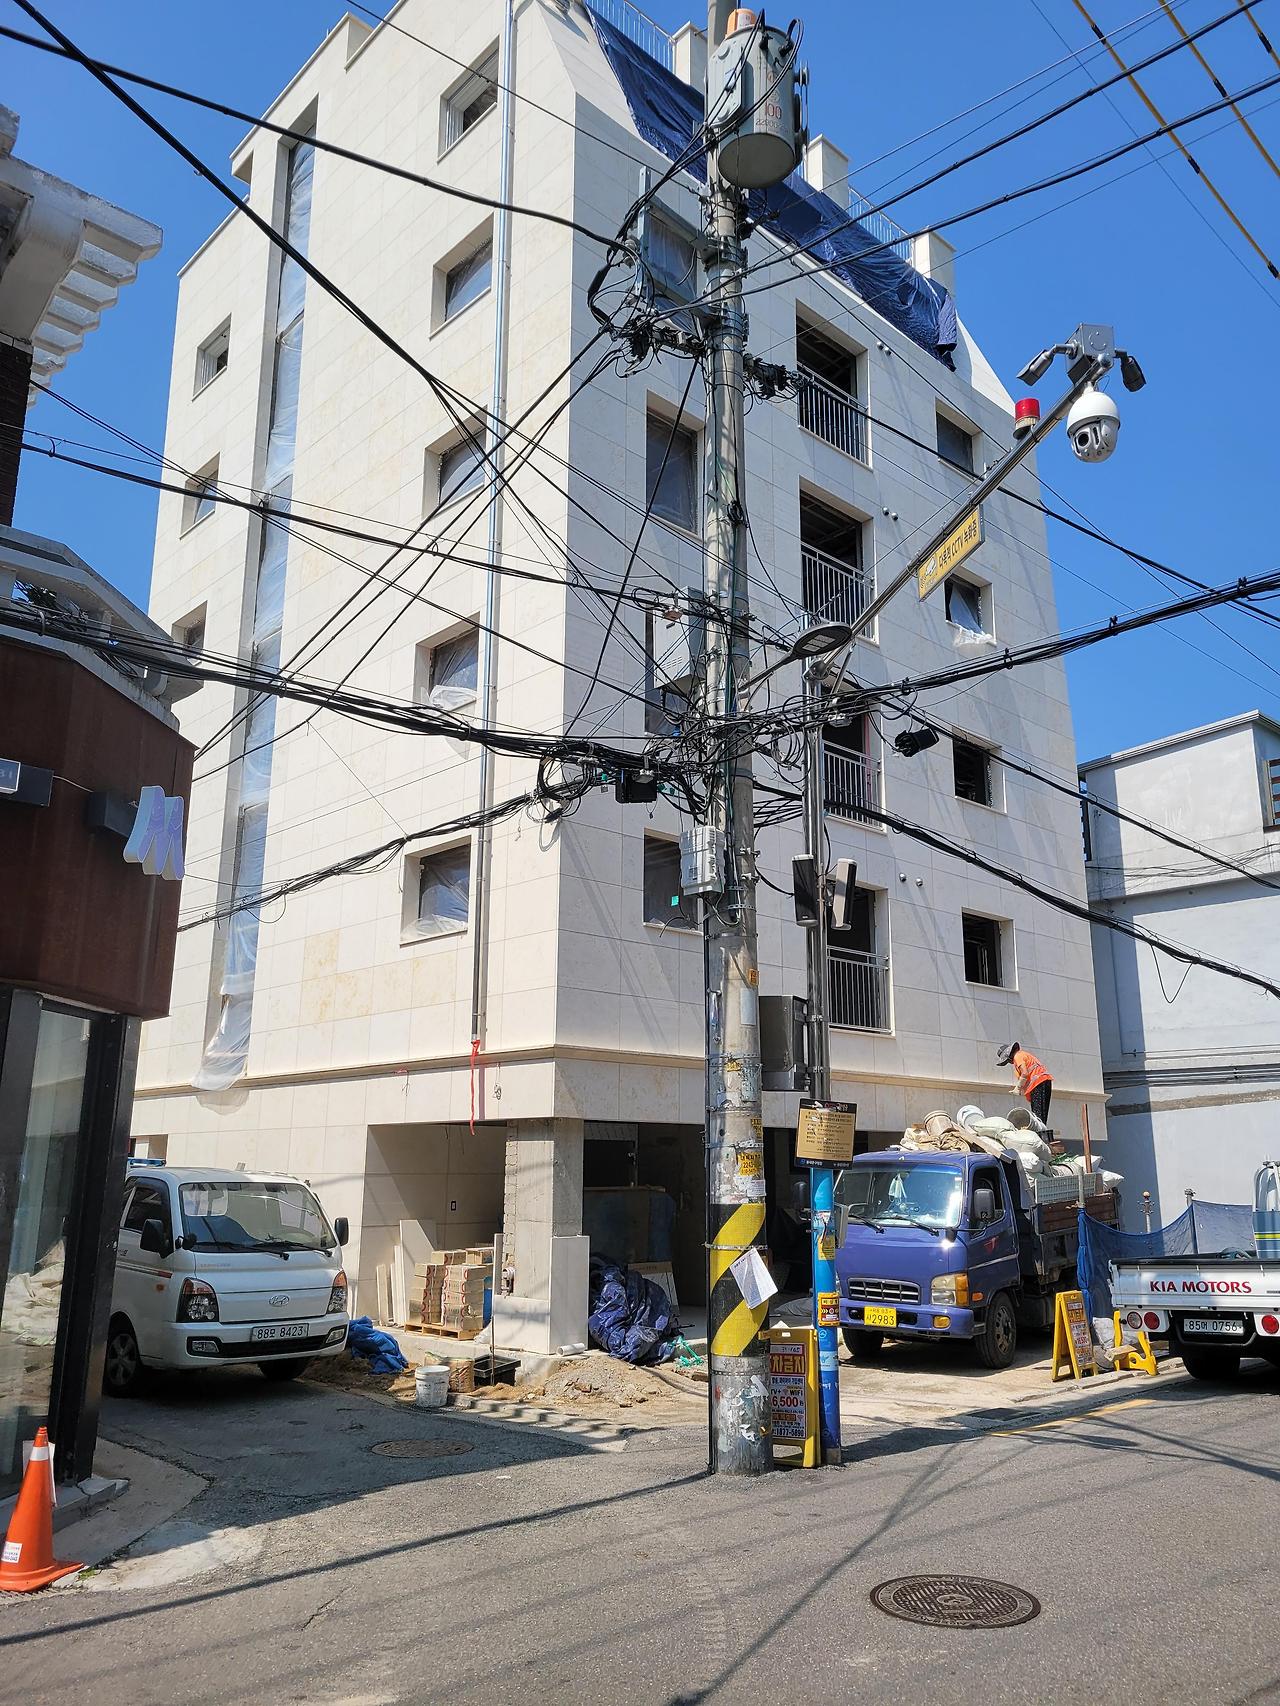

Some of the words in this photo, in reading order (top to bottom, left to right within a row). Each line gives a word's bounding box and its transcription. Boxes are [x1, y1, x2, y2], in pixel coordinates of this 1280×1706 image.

[951, 534, 964, 557] CCTV
[1150, 1280, 1177, 1293] KIA
[1182, 1280, 1252, 1294] MOTORS
[257, 1328, 276, 1340] 88모
[279, 1326, 304, 1338] 8423
[1188, 1320, 1208, 1331] 85어
[1212, 1320, 1238, 1332] 0756
[769, 1355, 805, 1374] 차금지
